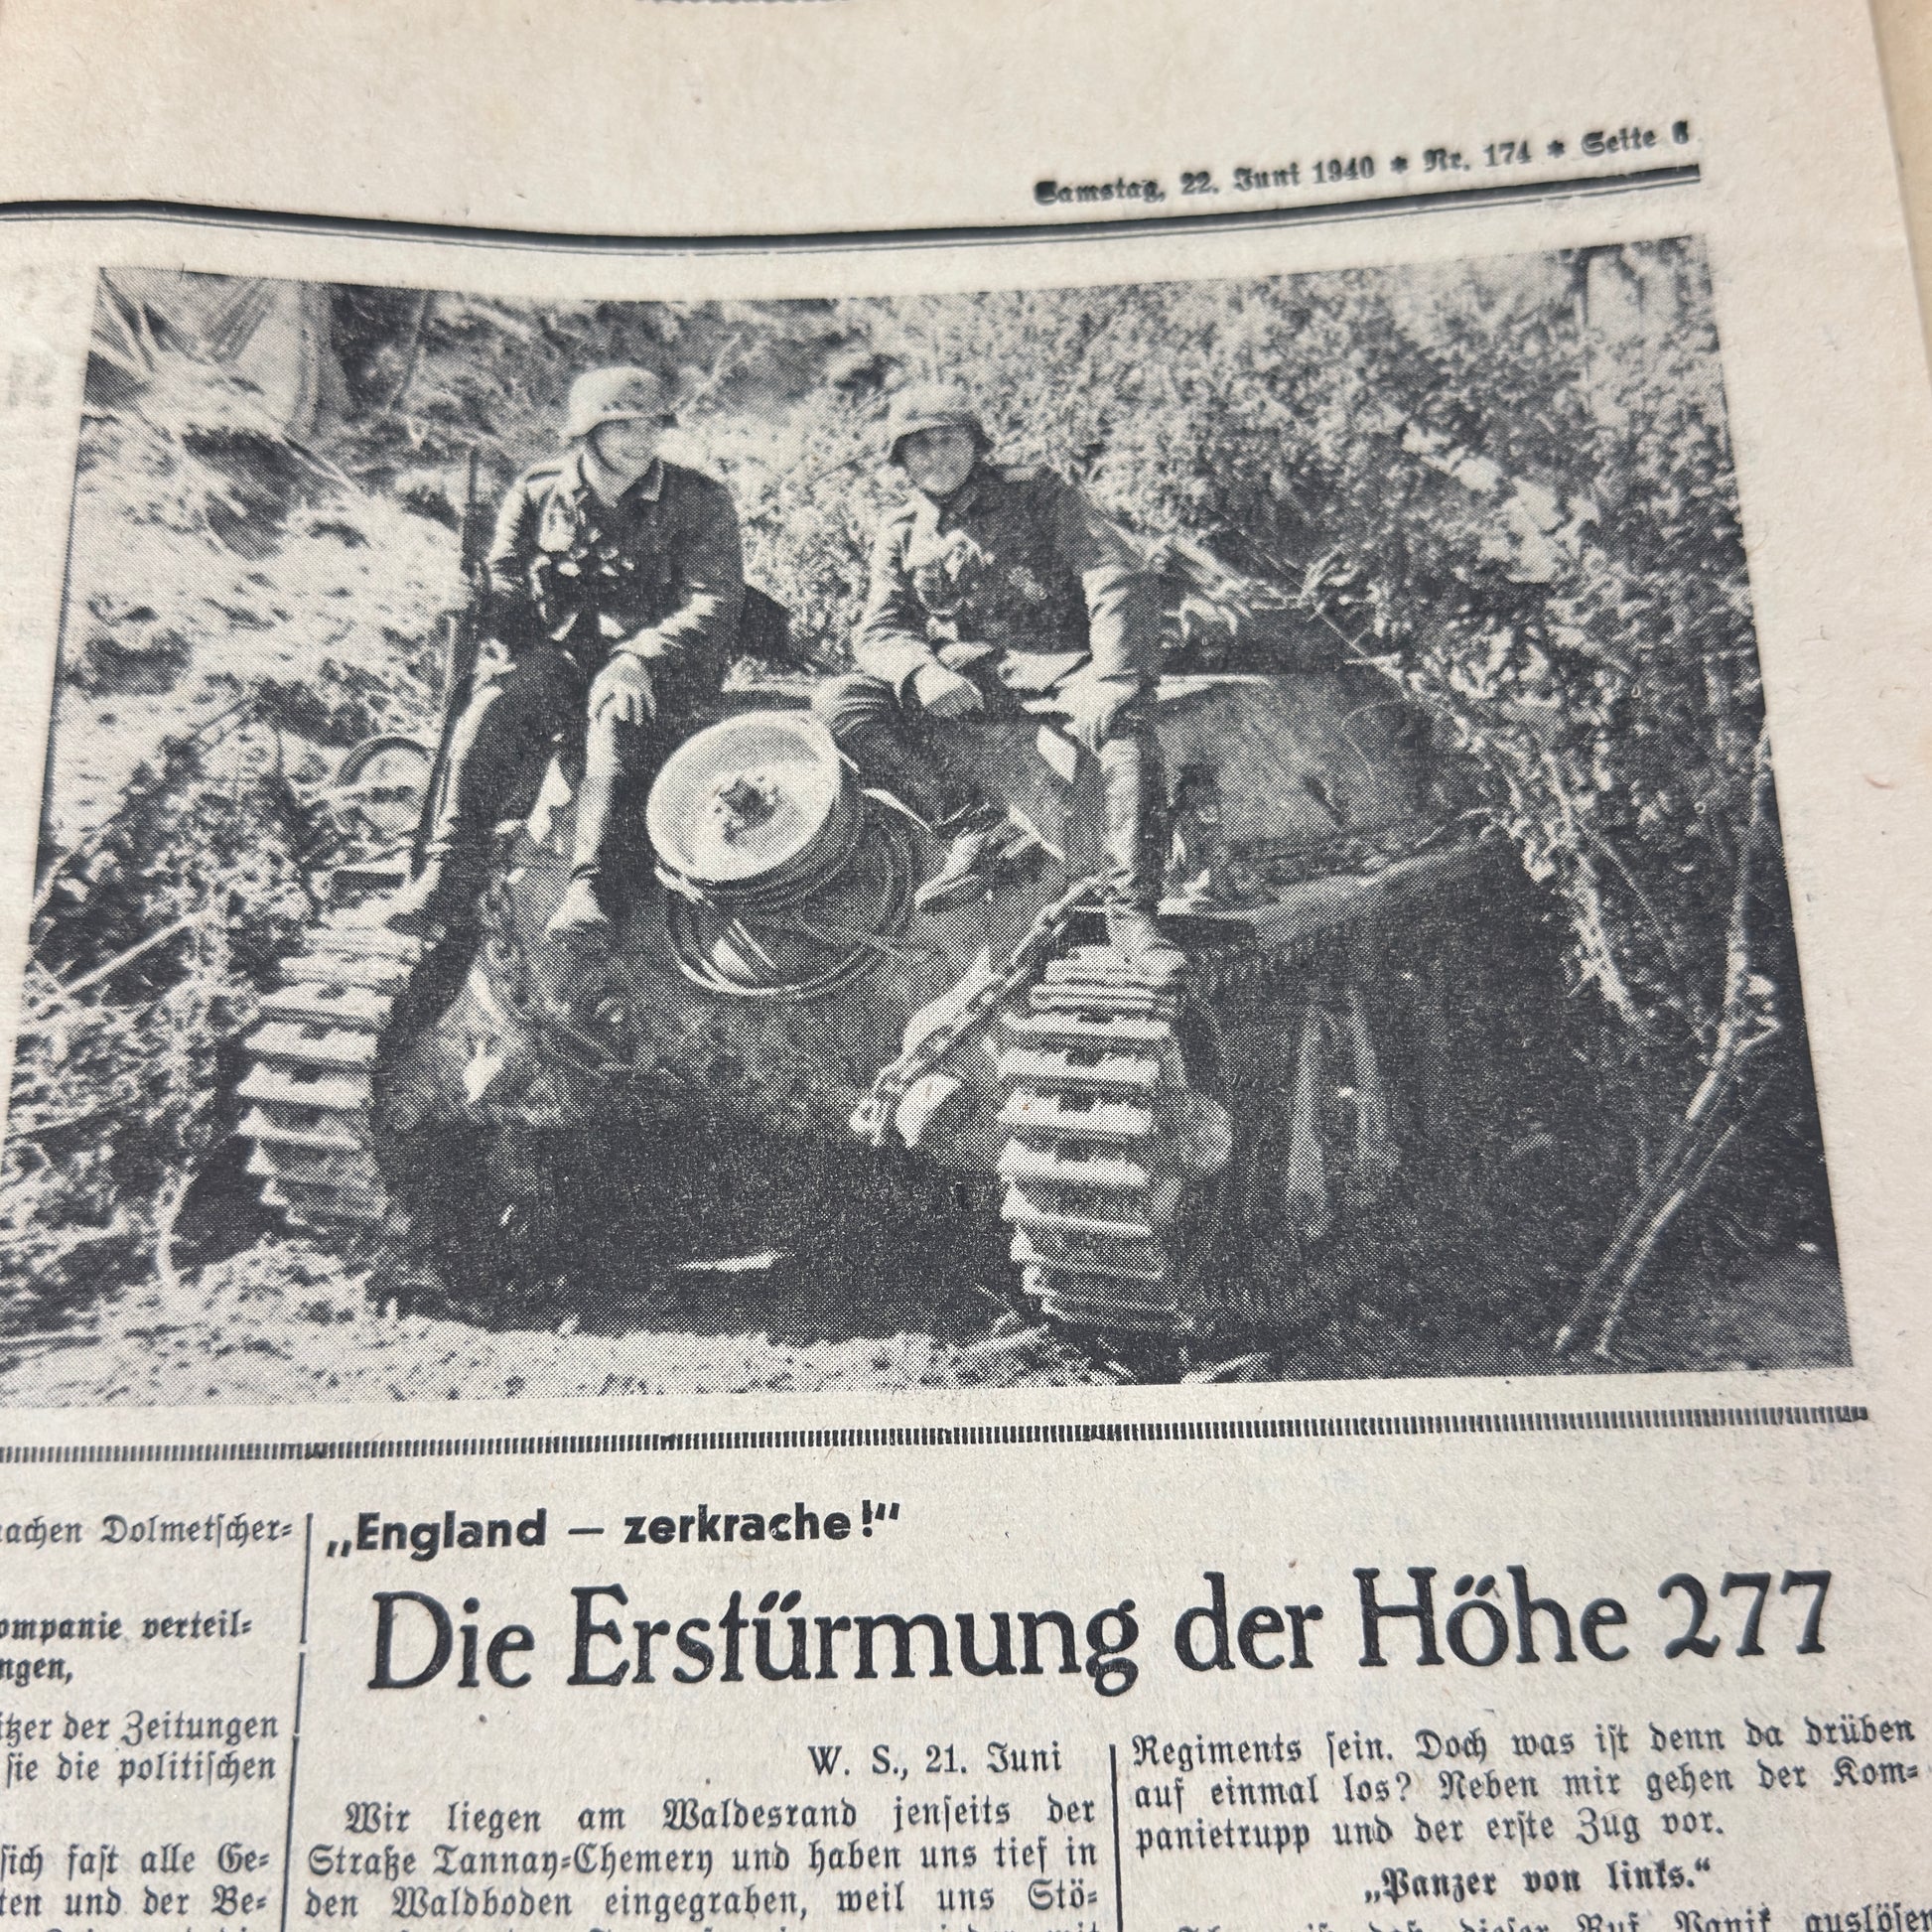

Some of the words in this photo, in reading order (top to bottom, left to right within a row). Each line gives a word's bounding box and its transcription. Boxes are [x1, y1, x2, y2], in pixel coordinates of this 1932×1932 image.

[1032, 176, 1167, 207] Samstag,
[1179, 169, 1220, 196] 22.
[1233, 161, 1301, 192] Juni
[1311, 154, 1376, 184] 1940
[1423, 146, 1470, 173] Nr.
[1483, 139, 1533, 167] 174
[1581, 126, 1658, 158] Seite
[0, 1515, 83, 1551] achen
[366, 1589, 535, 1692] Die
[566, 1583, 1140, 1698] Erstürmung
[1173, 1571, 1324, 1673] der
[1351, 1564, 1631, 1668] Höhe
[1657, 1569, 1834, 1661] 277
[62, 1710, 111, 1741] der
[119, 1710, 279, 1747] Zeitungen
[1131, 1731, 1303, 1773] Regiments
[1414, 1726, 1488, 1765] Doch
[1510, 1732, 1576, 1757] was
[1648, 1722, 1726, 1753] denn
[1743, 1717, 1785, 1748] da
[1803, 1713, 1916, 1747] drüben
[56, 1750, 100, 1782] die
[806, 1744, 851, 1777] W.
[872, 1743, 908, 1782] S.,
[925, 1742, 967, 1775] 21.
[986, 1739, 1062, 1774] Juni
[1135, 1776, 1185, 1815] auf
[1210, 1772, 1319, 1807] einmal
[1342, 1770, 1412, 1804] los?
[1438, 1768, 1540, 1803] Neben
[1561, 1765, 1621, 1798] mir
[1646, 1761, 1734, 1802] gehen
[1756, 1758, 1808, 1791] der
[345, 1801, 411, 1835] Wir
[447, 1800, 542, 1840] liegen
[577, 1807, 626, 1831] am
[661, 1796, 857, 1832] Waldesrand
[1046, 1792, 1095, 1825] der
[1135, 1817, 1311, 1860] panietrupp
[1331, 1813, 1394, 1847] und
[1413, 1812, 1464, 1845] der
[1575, 1806, 1641, 1846] Zug
[1660, 1811, 1725, 1836] vor.
[140, 1842, 196, 1874] alle
[307, 1843, 417, 1882] Straße
[732, 1840, 790, 1872] und
[807, 1838, 901, 1878] haben
[919, 1845, 978, 1869] uns
[993, 1835, 1048, 1874] tief
[1064, 1835, 1098, 1867] in
[1521, 1868, 1582, 1894] von
[64, 1885, 122, 1917] und
[142, 1884, 191, 1917] der
[304, 1886, 358, 1919] den
[390, 1885, 573, 1920] Waldboden
[605, 1883, 807, 1925] eingegraben,
[835, 1879, 905, 1914] weil
[936, 1887, 995, 1913] uns
